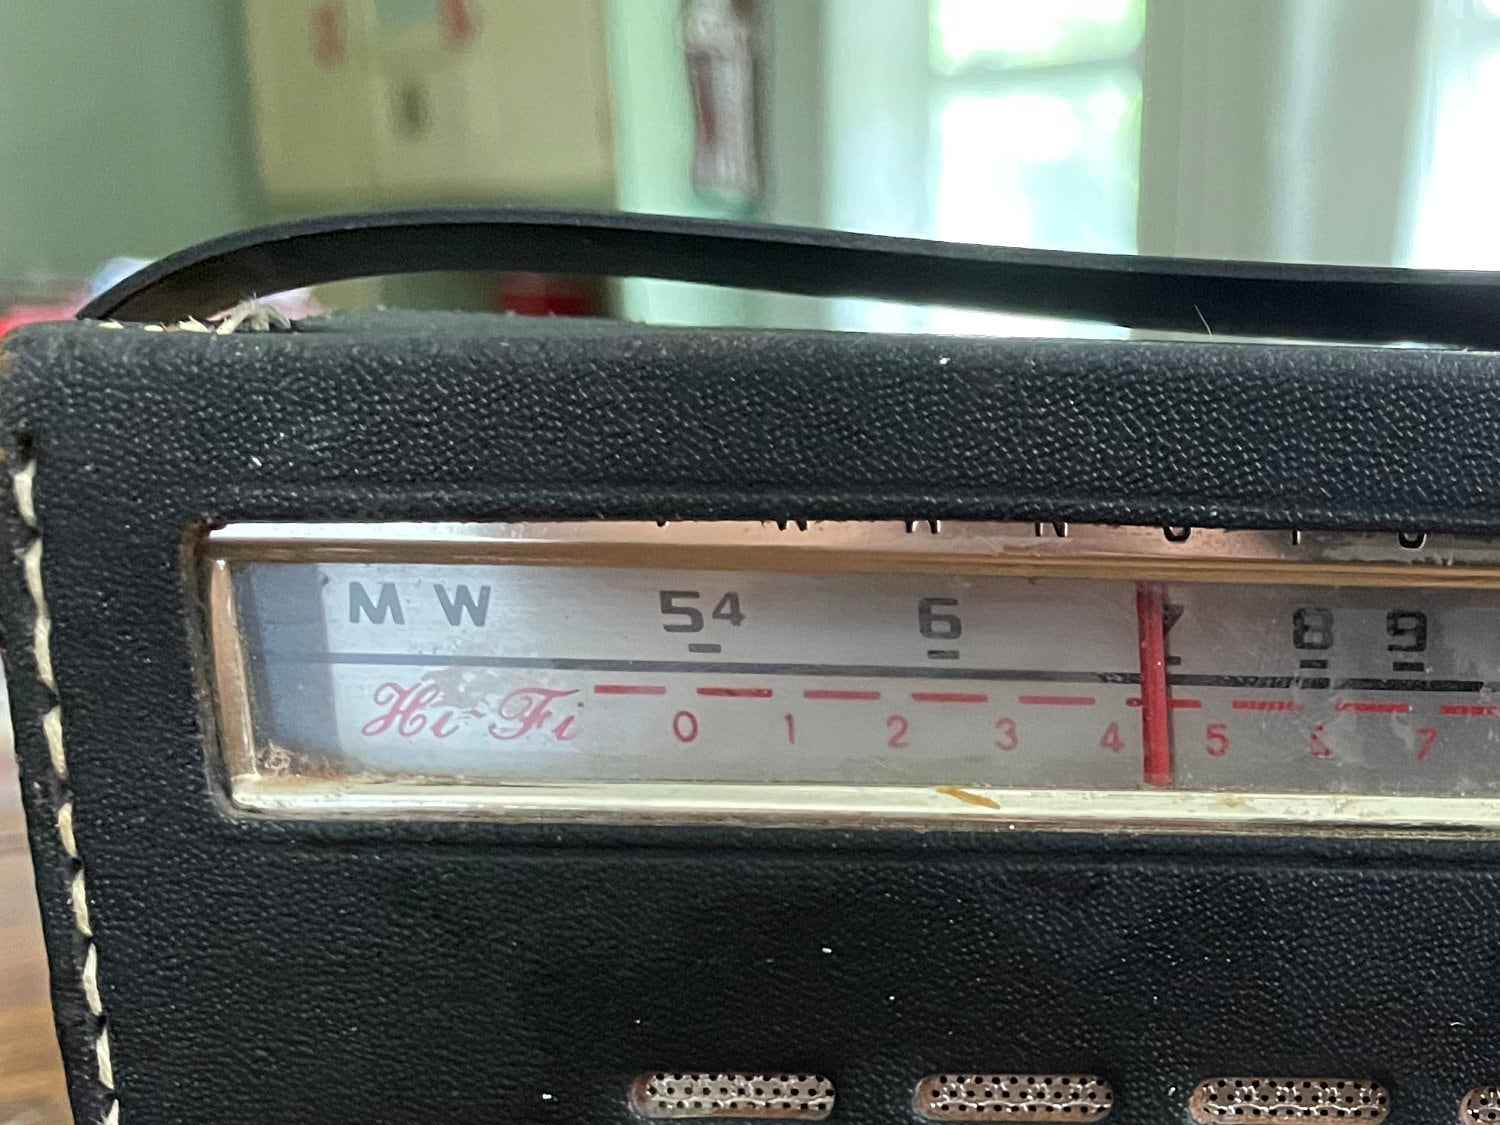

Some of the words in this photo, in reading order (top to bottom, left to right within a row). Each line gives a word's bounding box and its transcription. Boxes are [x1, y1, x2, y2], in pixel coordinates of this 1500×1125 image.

[659, 590, 746, 634] 54
[918, 597, 962, 641] 6
[1293, 607, 1333, 650] 8
[1386, 610, 1427, 653] 9
[672, 710, 699, 744] 0
[784, 713, 795, 744] 1
[886, 715, 910, 749] 2
[994, 717, 1019, 751] 3
[1101, 721, 1124, 754] 4
[1205, 722, 1230, 756] 5
[1415, 726, 1438, 760] 7
